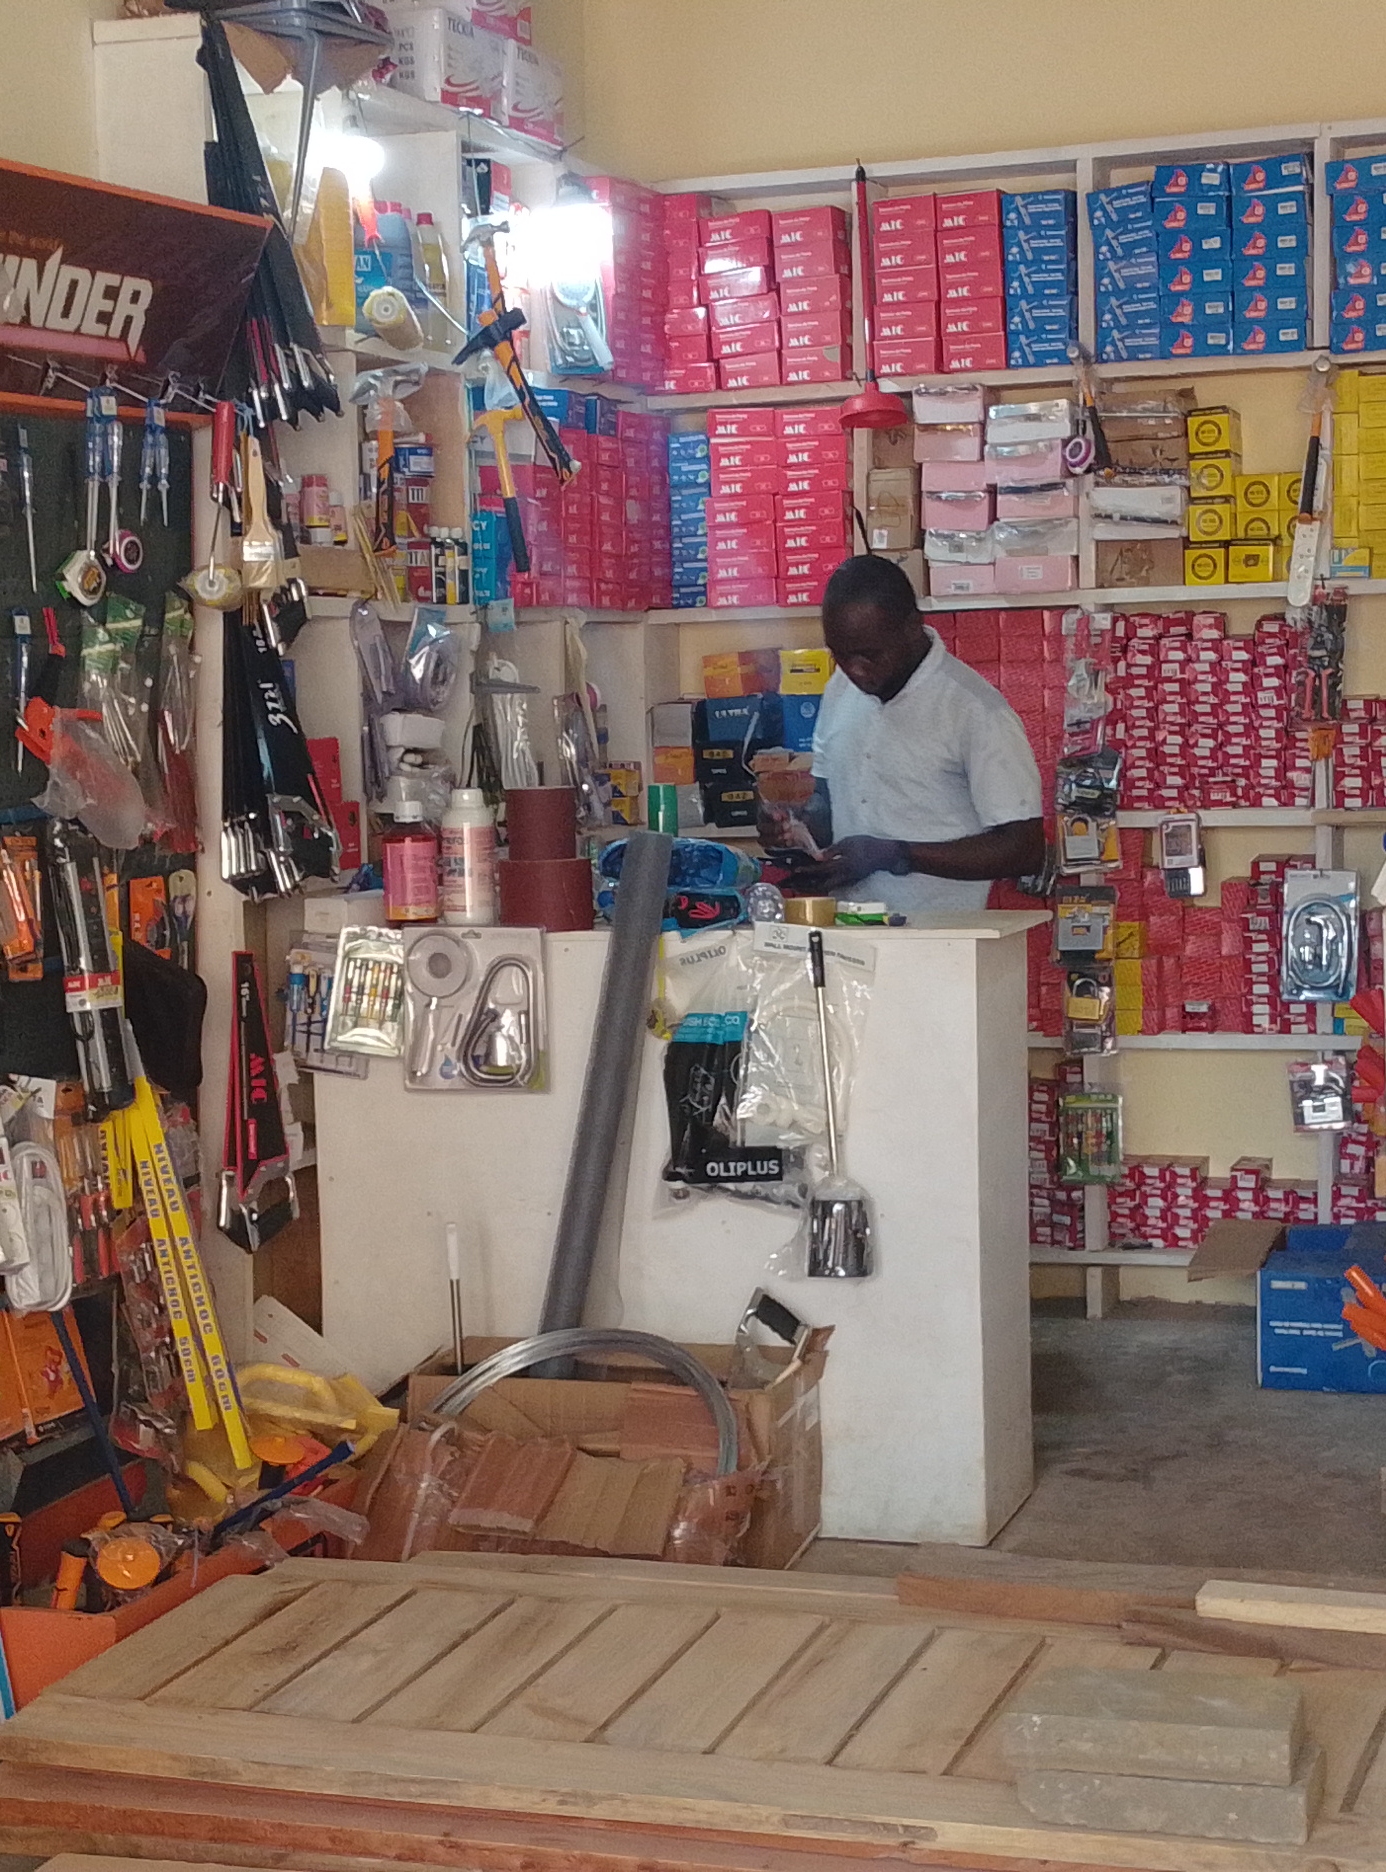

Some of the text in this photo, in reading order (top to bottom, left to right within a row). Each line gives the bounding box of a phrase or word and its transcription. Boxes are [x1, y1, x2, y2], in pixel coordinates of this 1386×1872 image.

[249, 1052, 267, 1104] MIC
[140, 1160, 160, 1218] NIVEAU
[154, 1143, 180, 1212] NIVEAU
[706, 1159, 780, 1178] OLIPLUS
